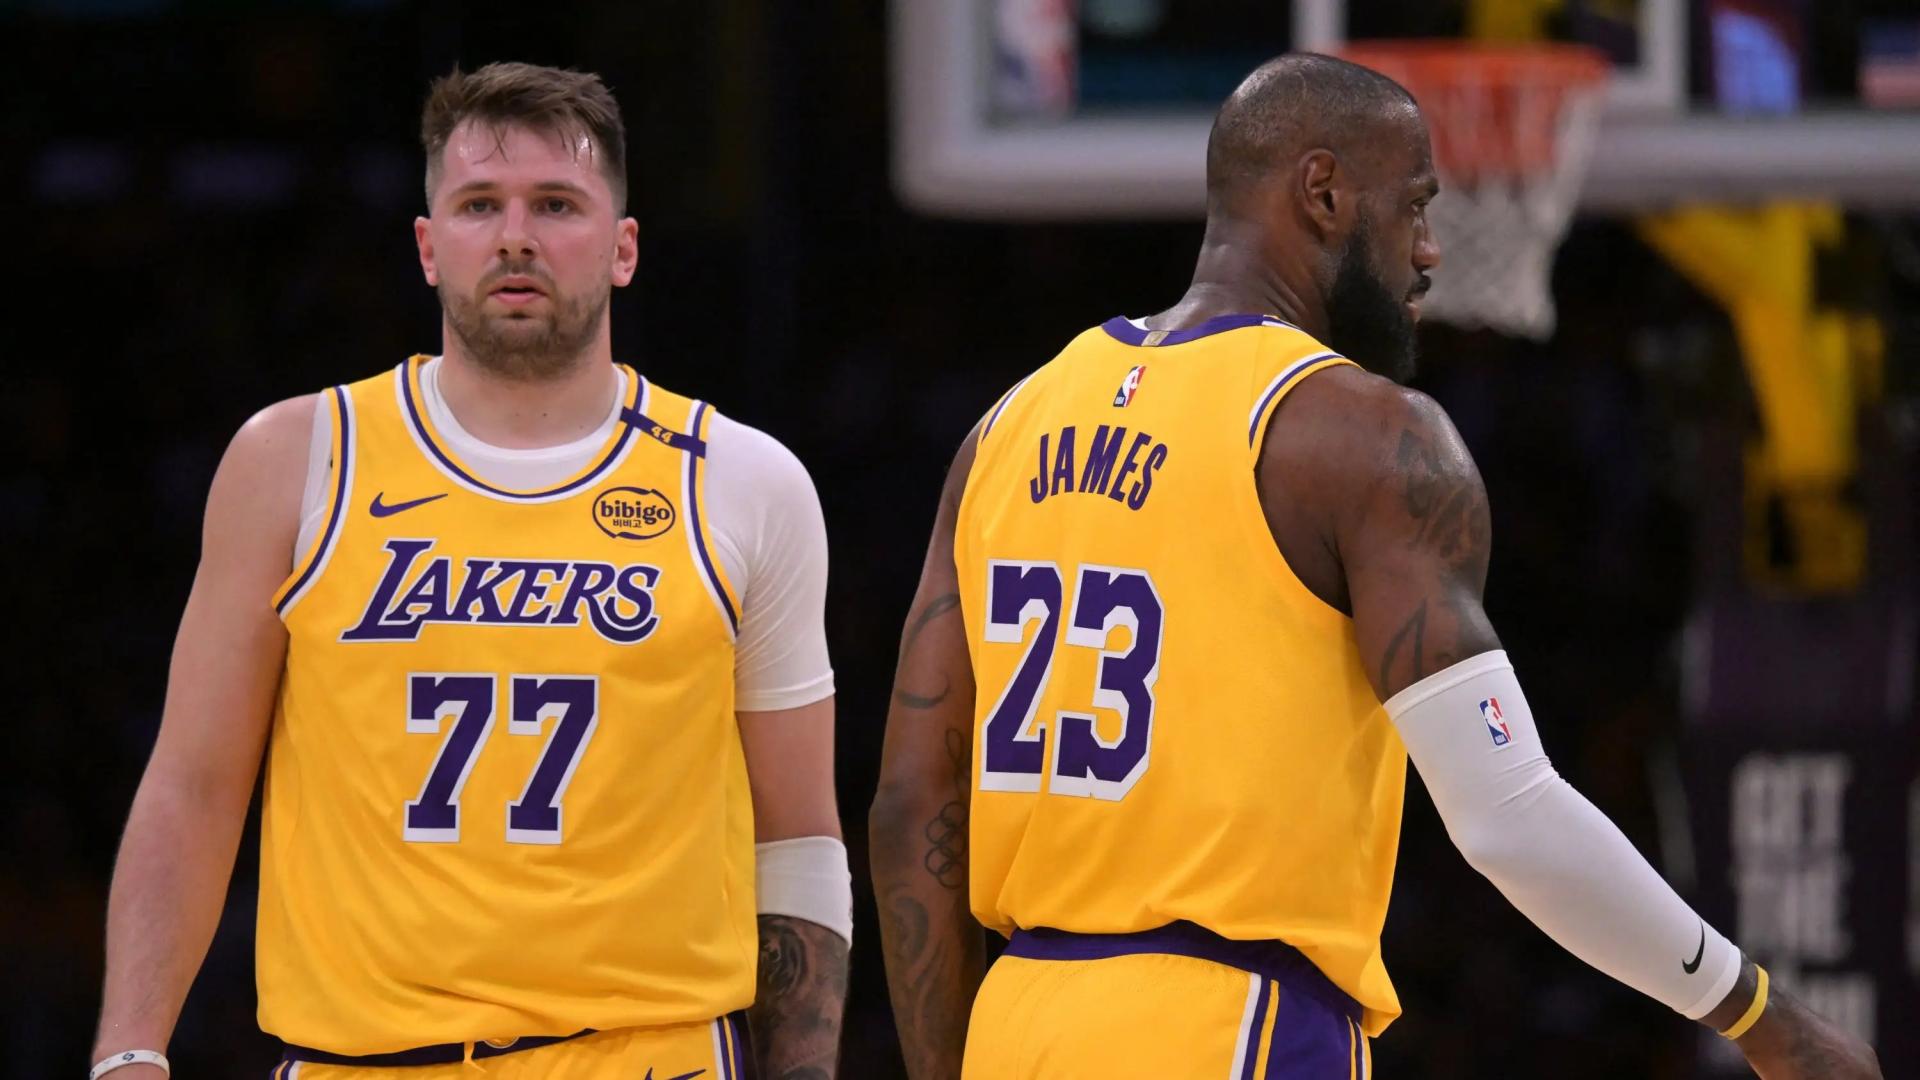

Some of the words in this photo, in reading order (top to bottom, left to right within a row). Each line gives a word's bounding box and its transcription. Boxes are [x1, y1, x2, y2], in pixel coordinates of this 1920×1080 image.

[651, 426, 673, 443] 44
[1030, 424, 1168, 511] JAMES
[600, 500, 670, 525] bibigo
[612, 519, 642, 529] 비비고
[338, 538, 662, 644] LAKERS
[980, 559, 1165, 801] 23
[403, 672, 600, 845] 77
